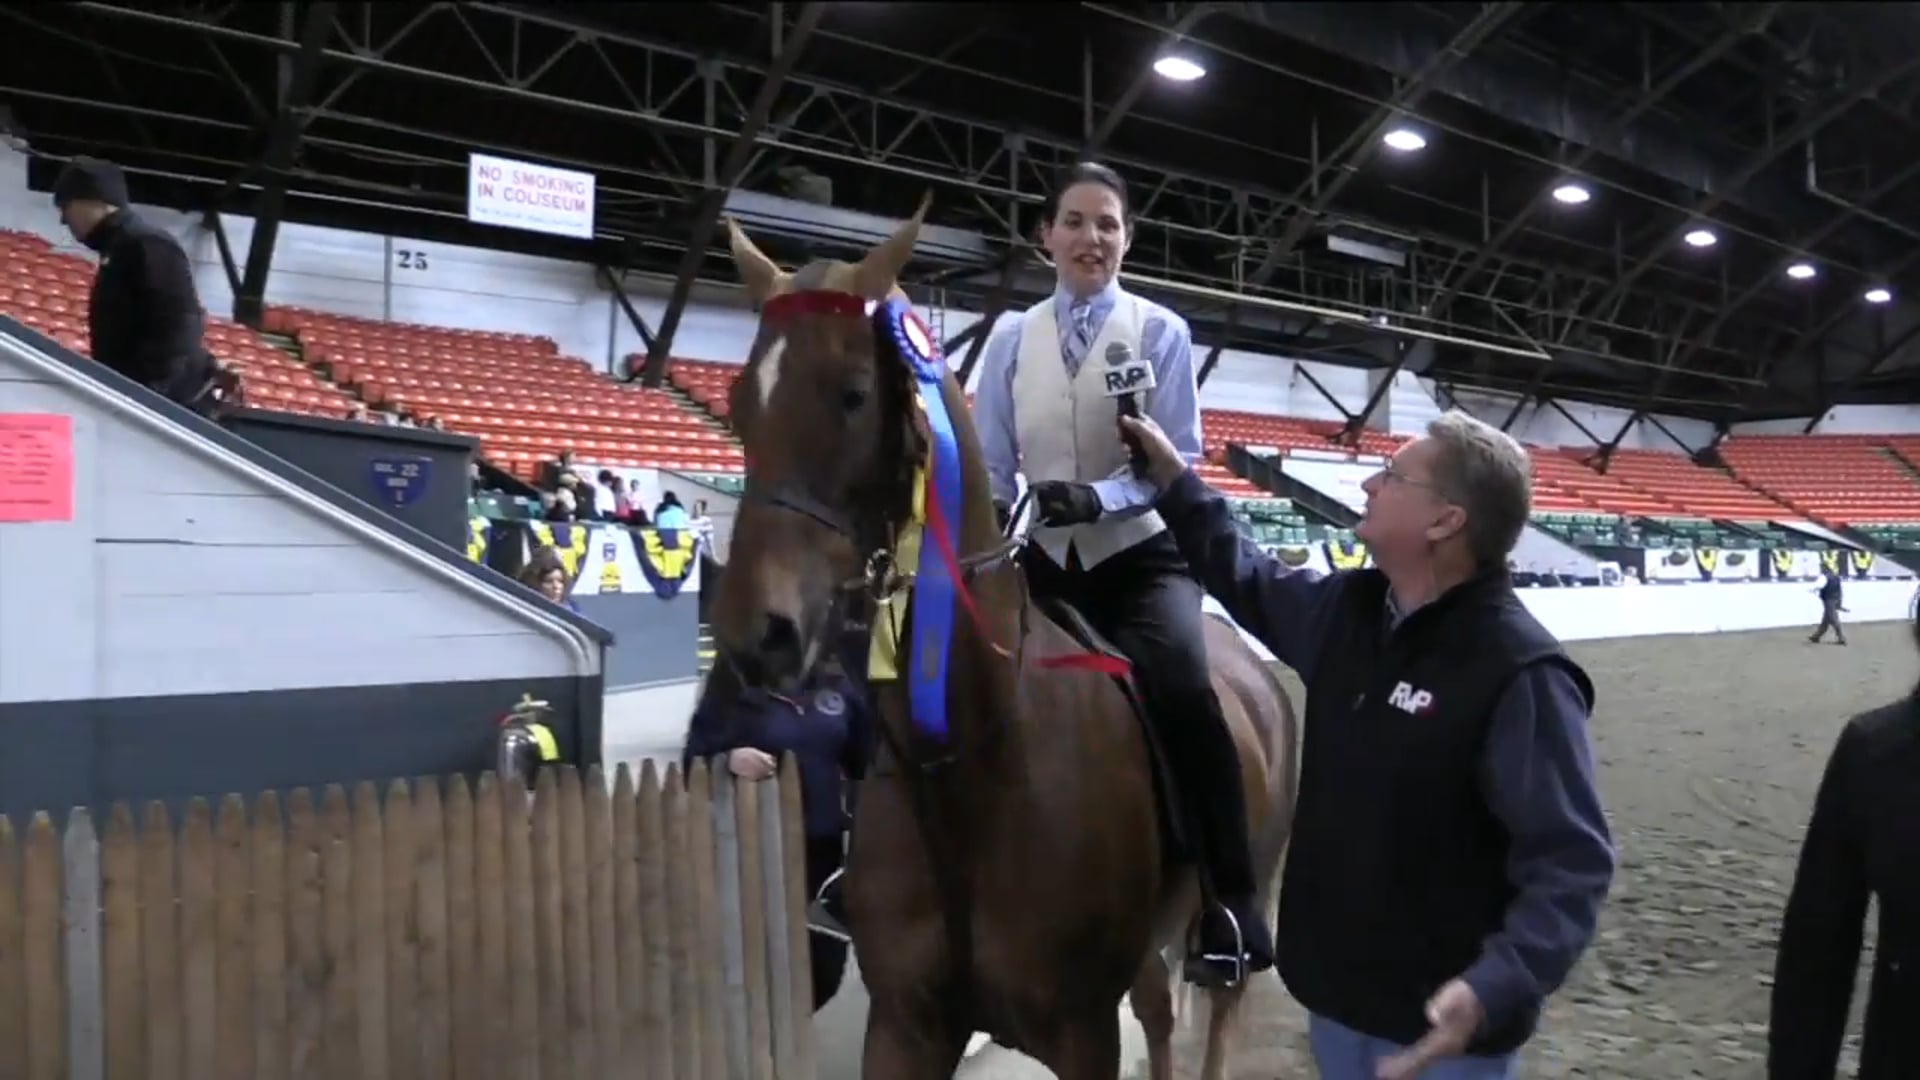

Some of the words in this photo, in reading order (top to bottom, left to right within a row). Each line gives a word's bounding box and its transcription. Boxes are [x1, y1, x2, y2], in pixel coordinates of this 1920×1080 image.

[478, 165, 502, 181] NO
[512, 170, 585, 196] SMOKING
[478, 182, 493, 199] IN
[503, 186, 586, 213] COLISEUM
[398, 249, 429, 271] 25
[1104, 367, 1146, 392] RVP
